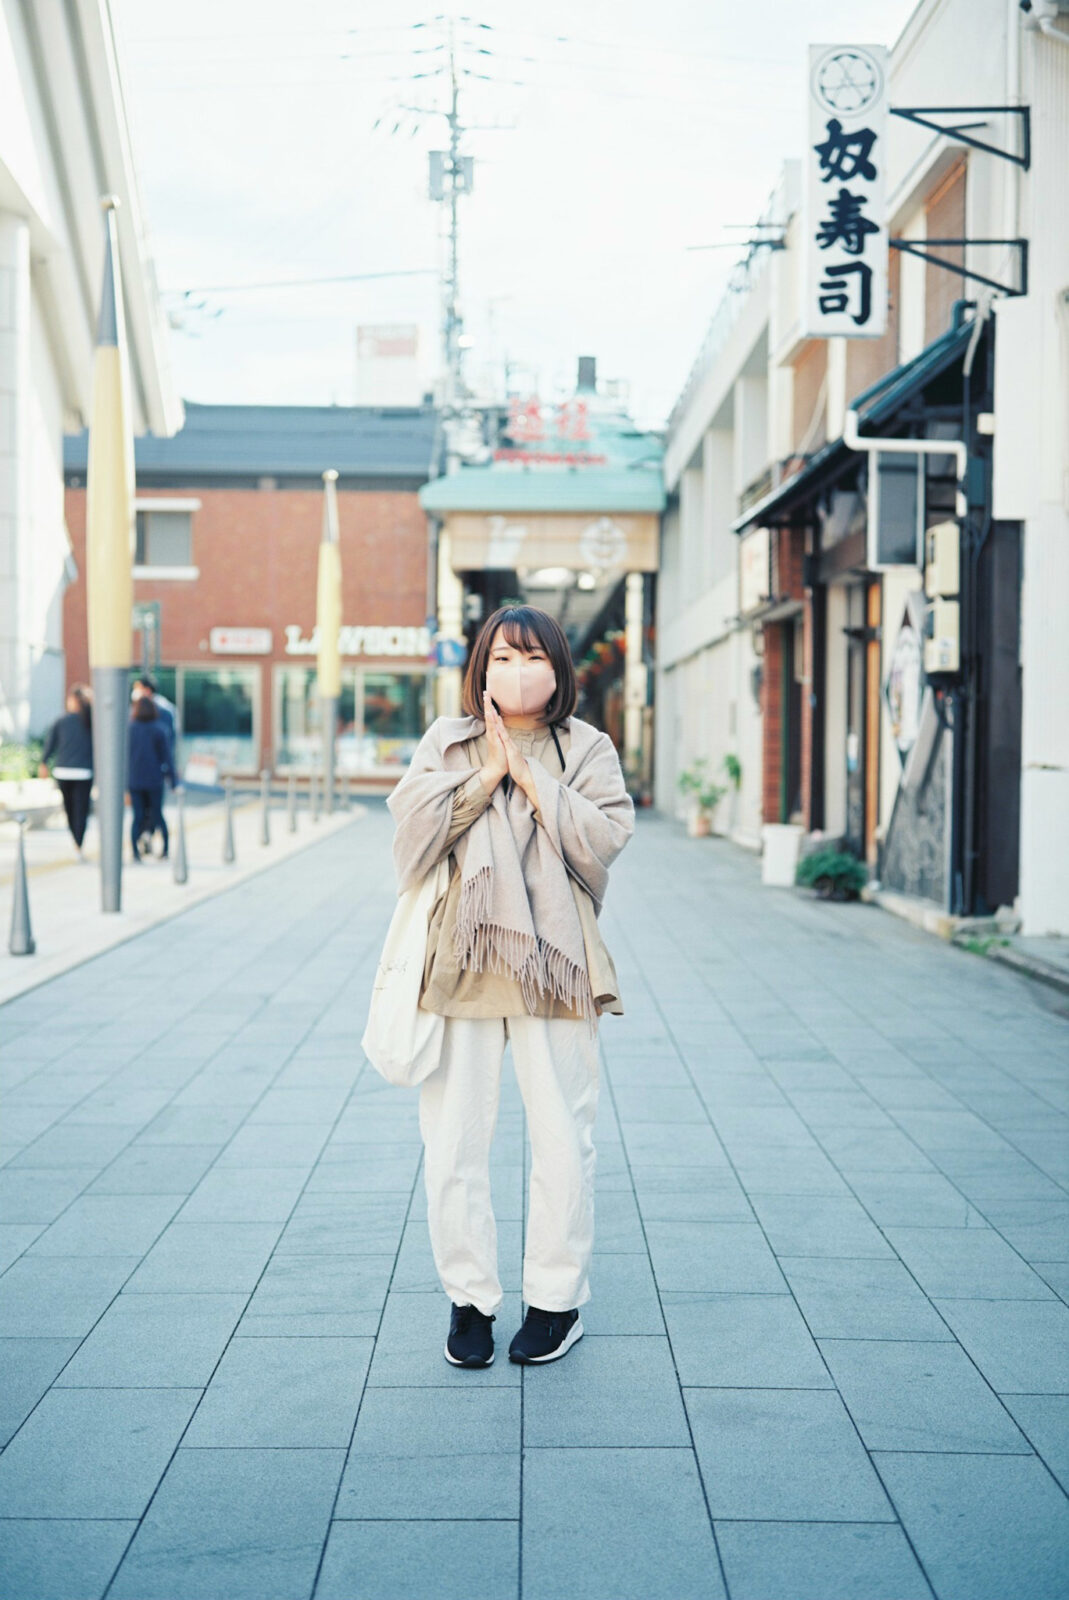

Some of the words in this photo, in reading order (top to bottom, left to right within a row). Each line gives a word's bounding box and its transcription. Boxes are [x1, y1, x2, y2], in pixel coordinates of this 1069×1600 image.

[814, 118, 880, 325] 奴寿司
[285, 625, 432, 655] LWSON
